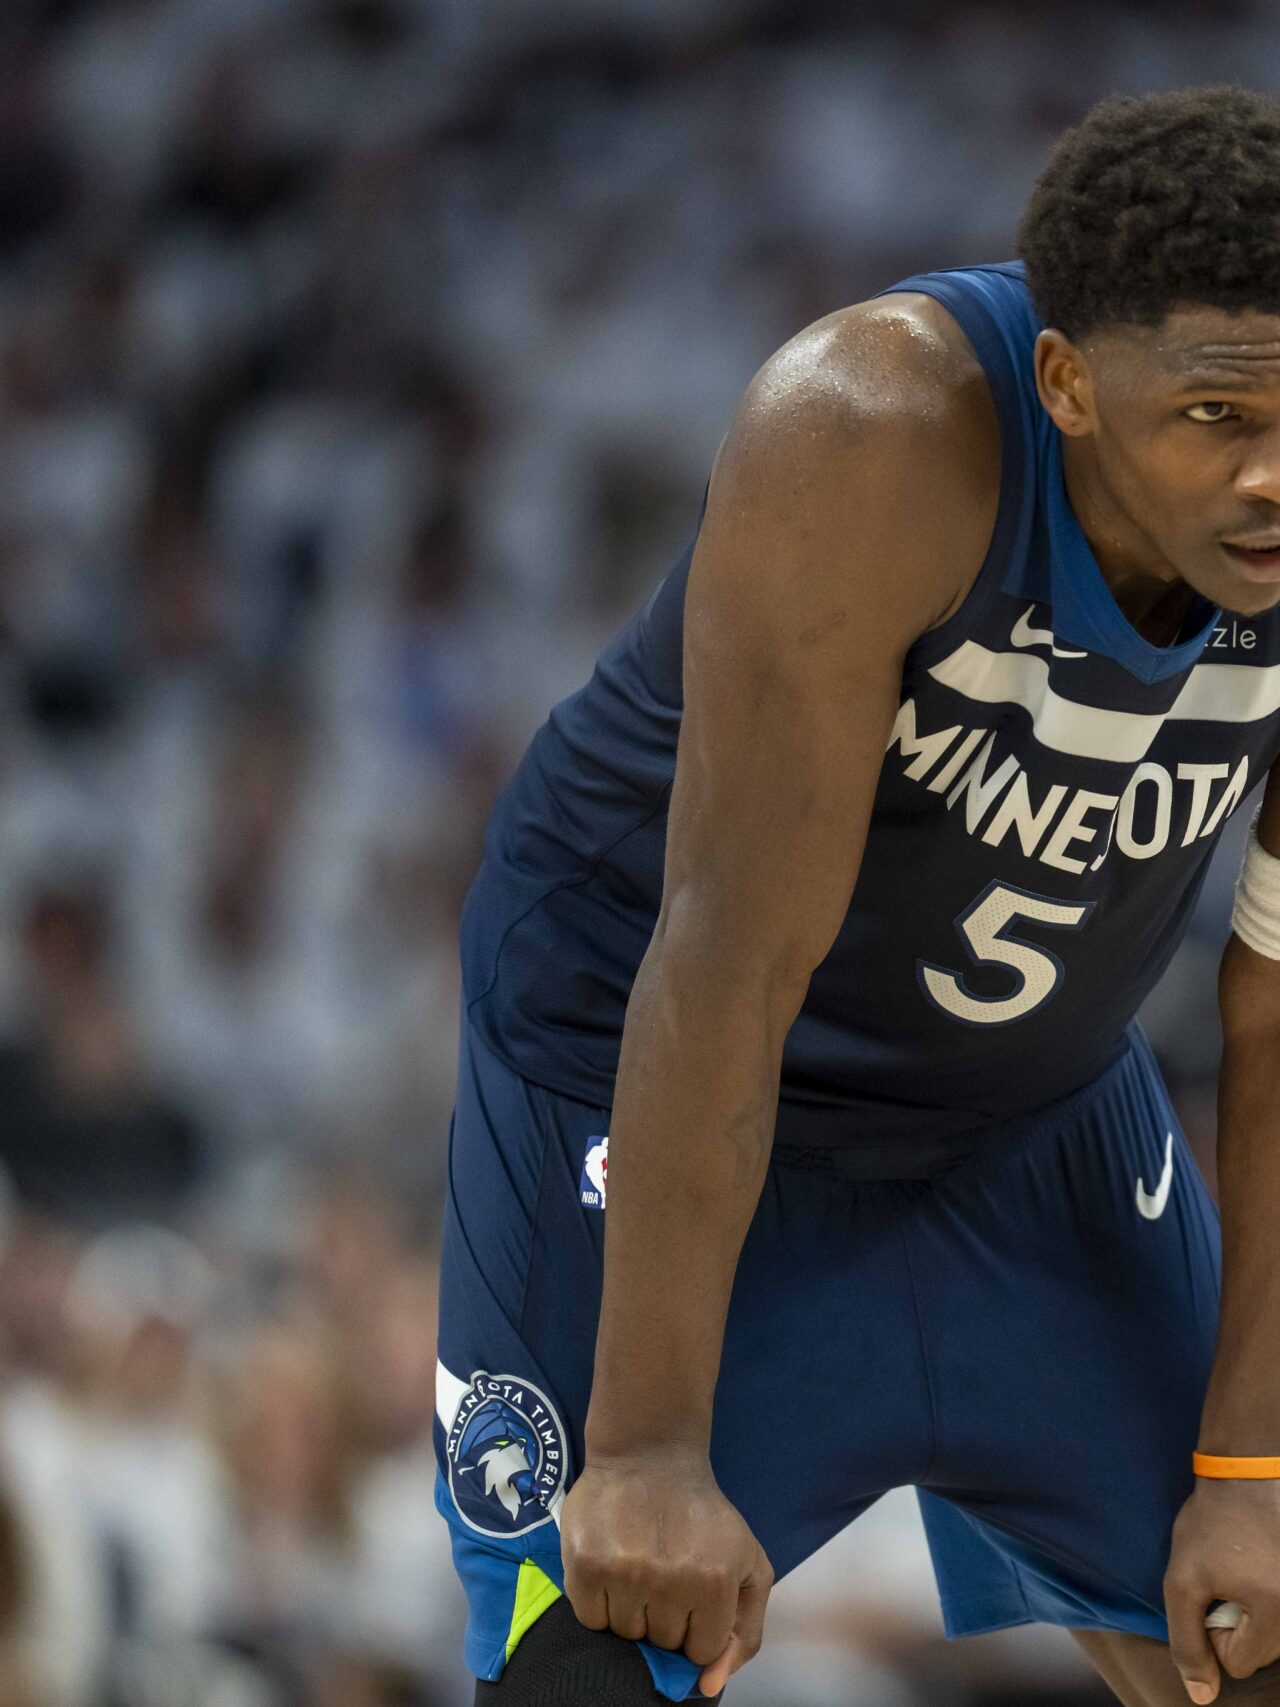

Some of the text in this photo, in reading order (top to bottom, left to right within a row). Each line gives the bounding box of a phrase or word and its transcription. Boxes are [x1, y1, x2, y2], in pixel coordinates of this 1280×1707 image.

[1204, 621, 1257, 650] zle
[886, 697, 1249, 875] MINNEOTA
[917, 879, 1098, 1028] 5
[581, 1191, 599, 1205] NBA
[448, 1380, 523, 1453] MINNOTA
